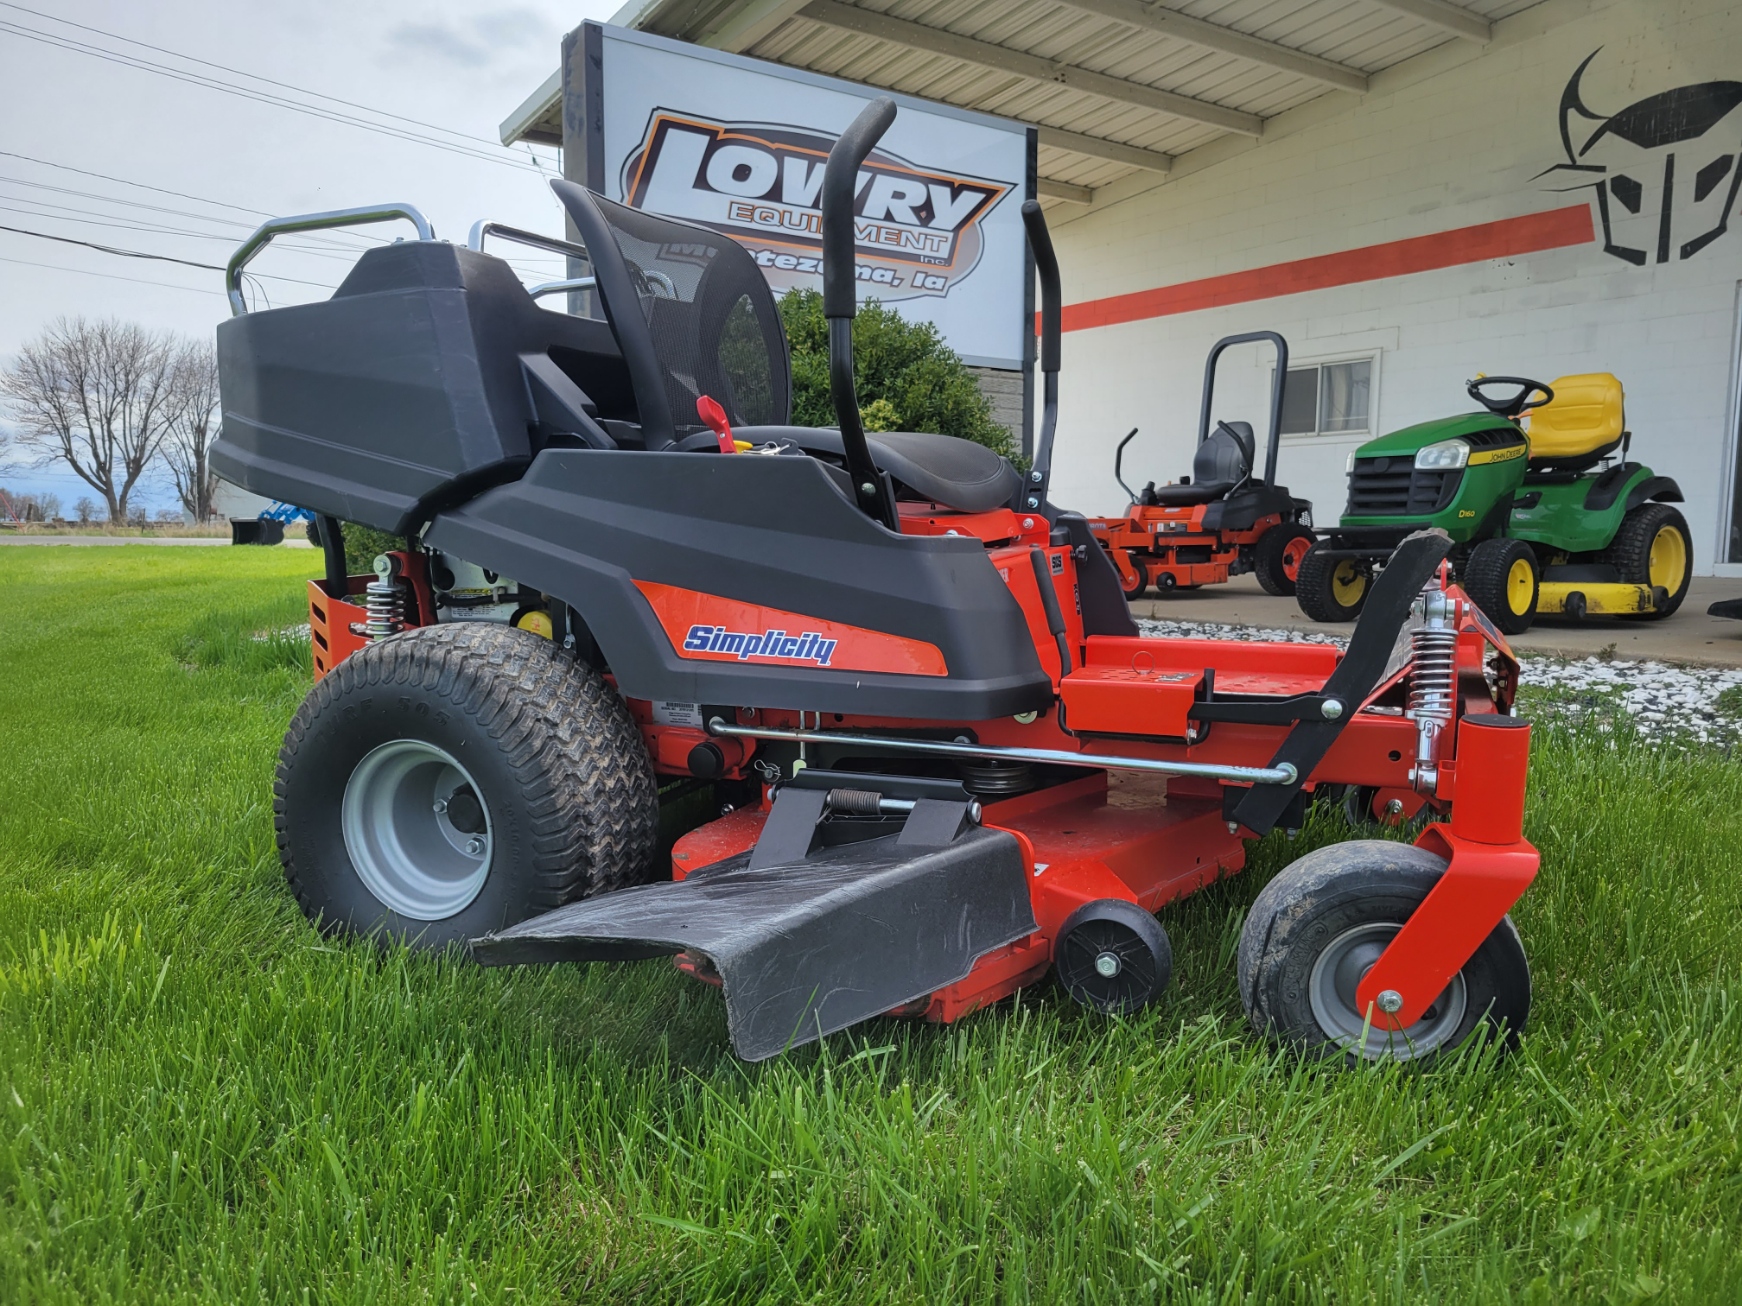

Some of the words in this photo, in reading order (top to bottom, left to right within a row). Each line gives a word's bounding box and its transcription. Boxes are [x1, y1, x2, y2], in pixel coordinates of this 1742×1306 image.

[641, 127, 987, 232] LOWRY
[728, 201, 949, 253] EQUIMENT
[919, 255, 950, 267] Inc.
[1458, 509, 1476, 518] D160
[683, 624, 838, 667] Simplicity
